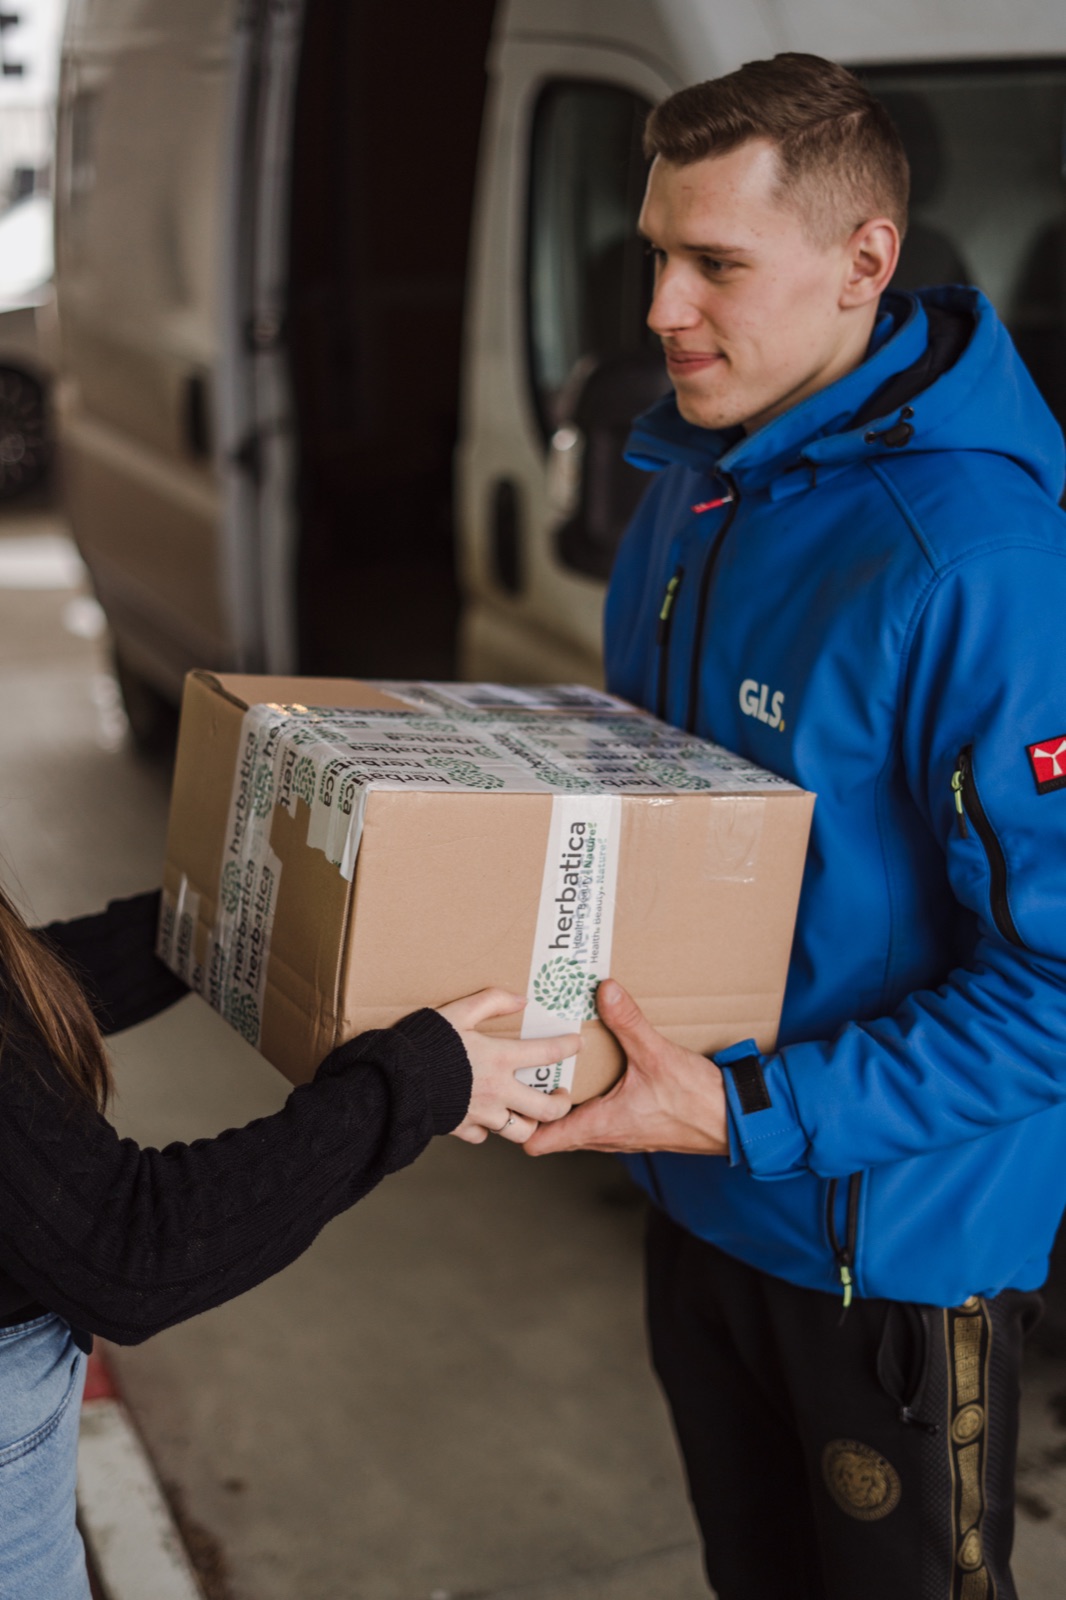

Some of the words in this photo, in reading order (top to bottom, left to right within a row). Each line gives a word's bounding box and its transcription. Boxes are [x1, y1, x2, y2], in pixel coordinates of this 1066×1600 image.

[229, 731, 257, 855] herbatica
[350, 744, 476, 757] herbatica
[233, 859, 257, 983] herbatica
[244, 865, 271, 989] herbatica
[548, 821, 586, 949] herbatica
